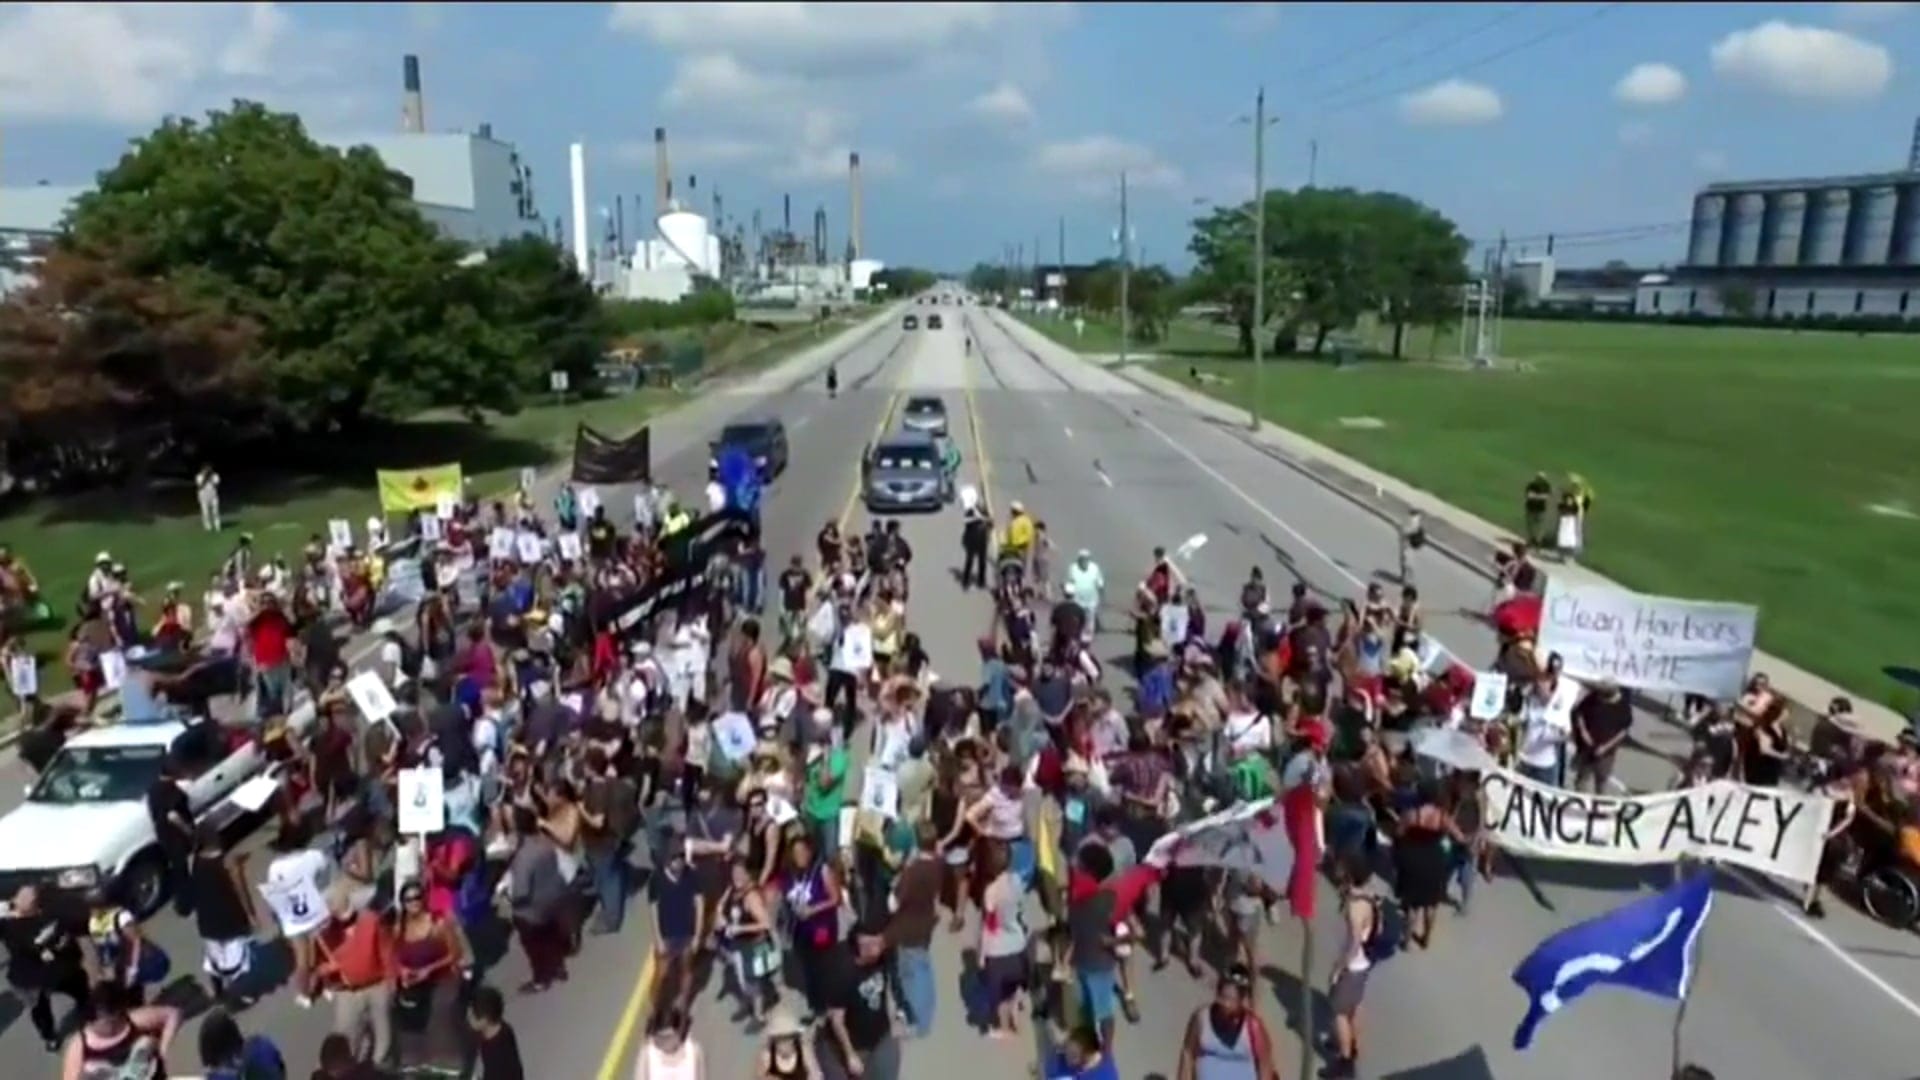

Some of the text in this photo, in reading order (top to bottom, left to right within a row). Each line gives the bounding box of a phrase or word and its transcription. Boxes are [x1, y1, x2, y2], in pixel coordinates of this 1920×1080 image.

[1551, 594, 1743, 645] Clean Harbors
[1583, 648, 1687, 683] SHAME
[1483, 775, 1644, 850] CANCER
